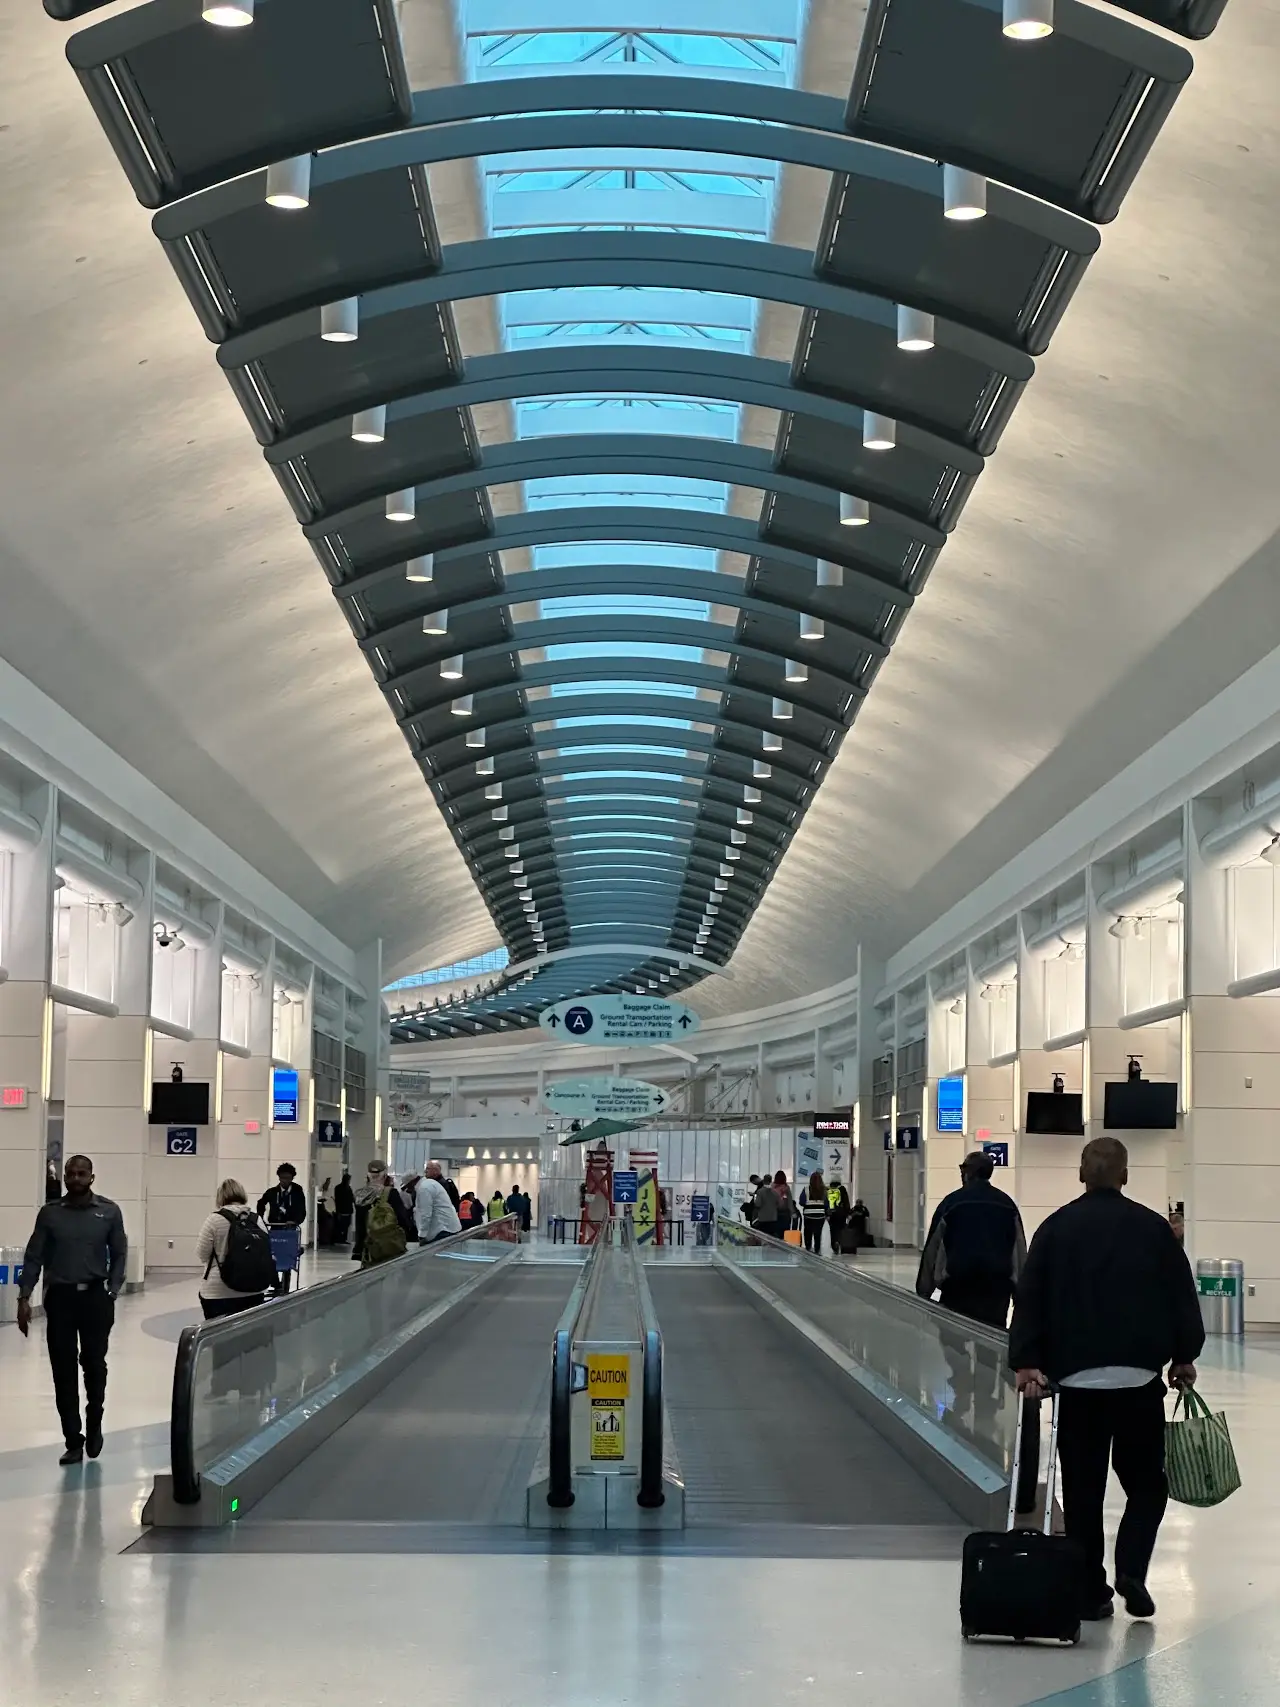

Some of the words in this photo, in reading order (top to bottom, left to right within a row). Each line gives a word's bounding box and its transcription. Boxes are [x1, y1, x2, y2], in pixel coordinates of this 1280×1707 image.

[623, 1004, 651, 1012] Baggage
[573, 1015, 586, 1028] A
[626, 1014, 673, 1022] Transportation
[170, 1138, 193, 1153] C2
[987, 1152, 1004, 1165] C1
[640, 1188, 650, 1226] JAX
[590, 1370, 627, 1383] CAUTION
